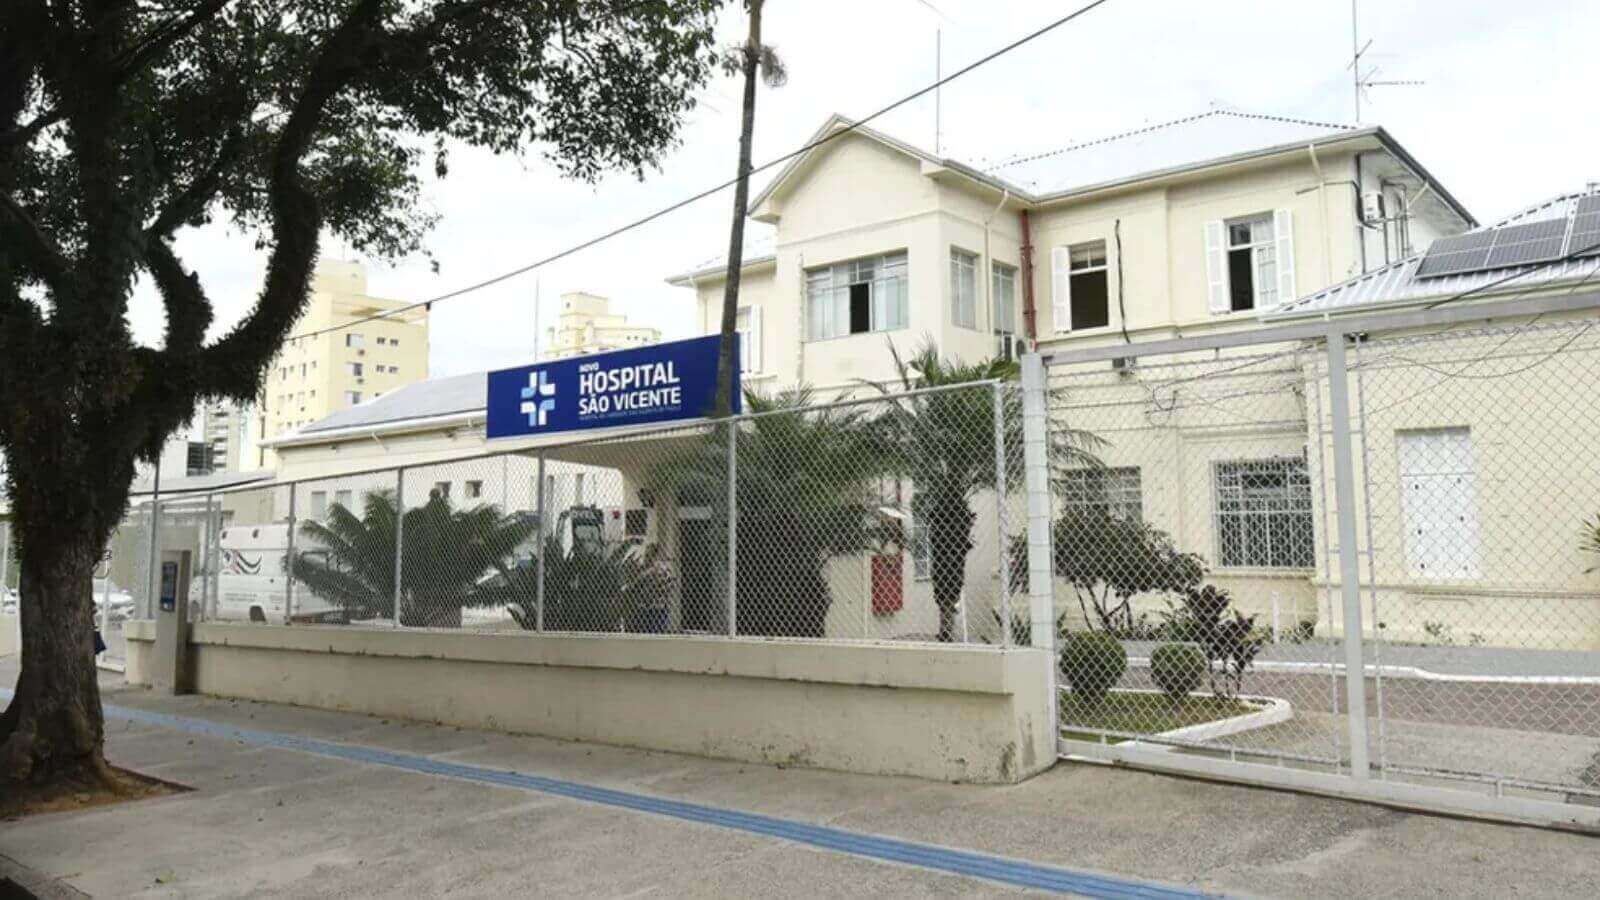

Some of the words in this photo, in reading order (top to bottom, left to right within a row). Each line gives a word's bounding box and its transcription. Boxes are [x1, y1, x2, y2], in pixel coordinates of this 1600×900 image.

[579, 362, 599, 372] NOVO
[580, 361, 680, 395] HOSPITAL
[579, 393, 609, 415] SÃO
[613, 387, 681, 410] VICENTE
